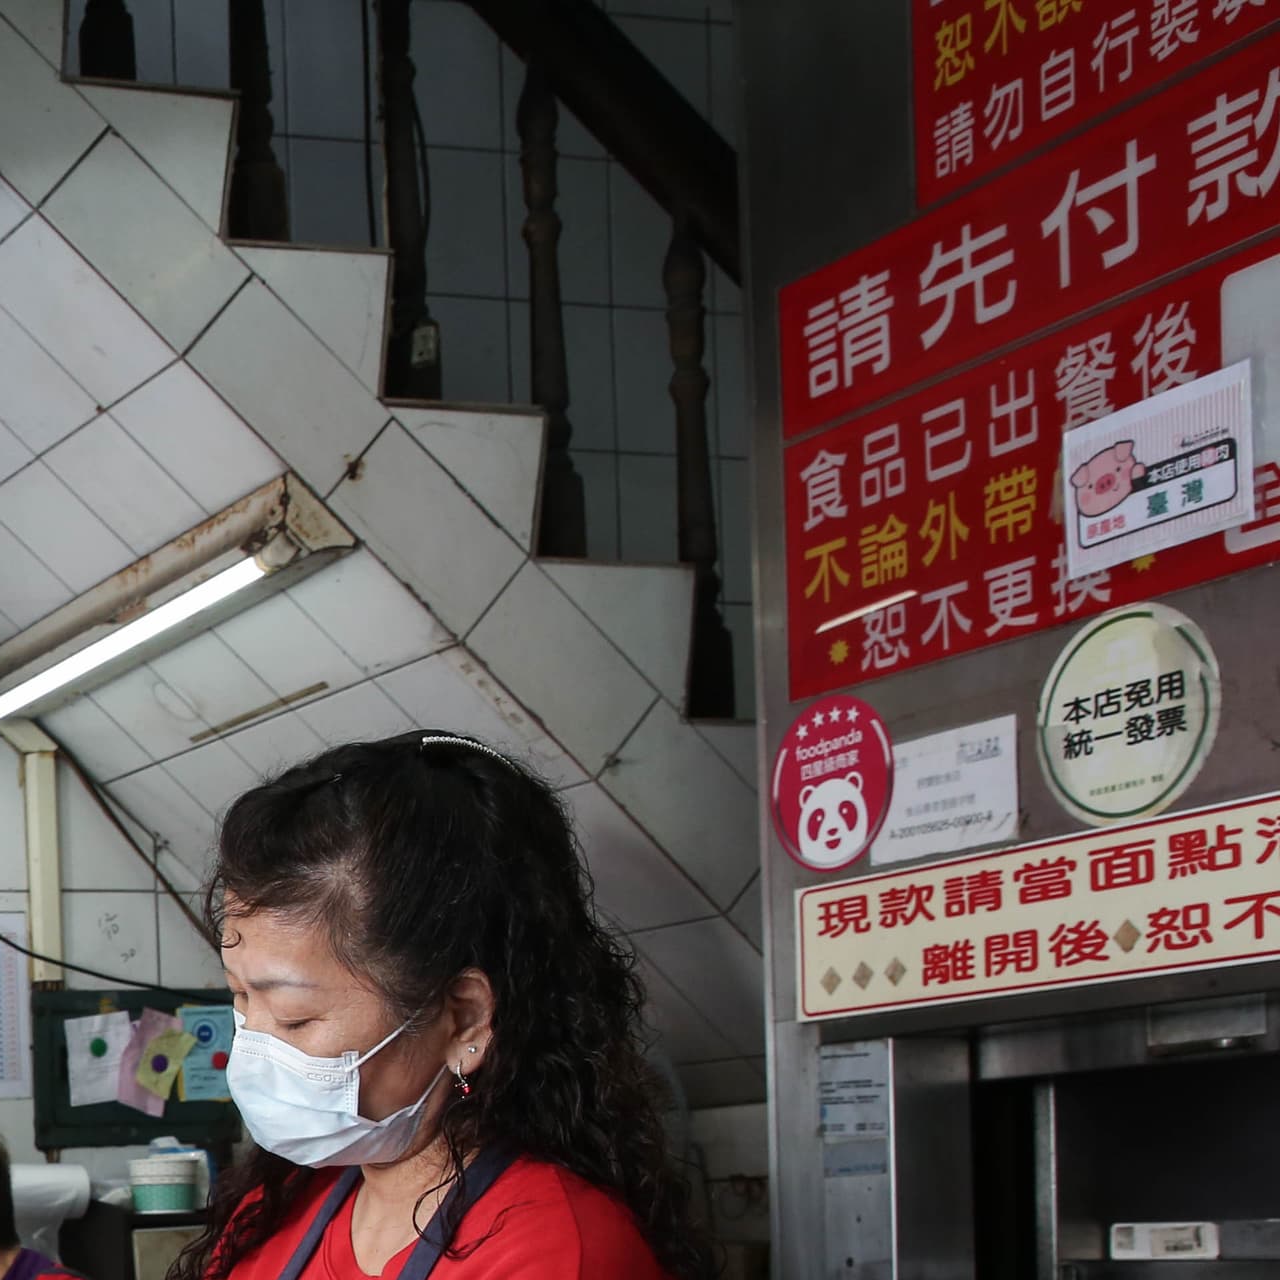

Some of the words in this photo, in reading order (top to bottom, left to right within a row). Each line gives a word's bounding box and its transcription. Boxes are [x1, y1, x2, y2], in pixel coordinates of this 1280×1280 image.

[933, 0, 1267, 179] 請勿自行裝
[803, 66, 1280, 399] 請先付款
[800, 301, 1199, 533] 食品已出餐後
[804, 464, 1068, 604] 不論外帶
[795, 727, 863, 763] foodpanda
[1063, 670, 1186, 727] 本店免用
[1063, 704, 1189, 762] 統一發票
